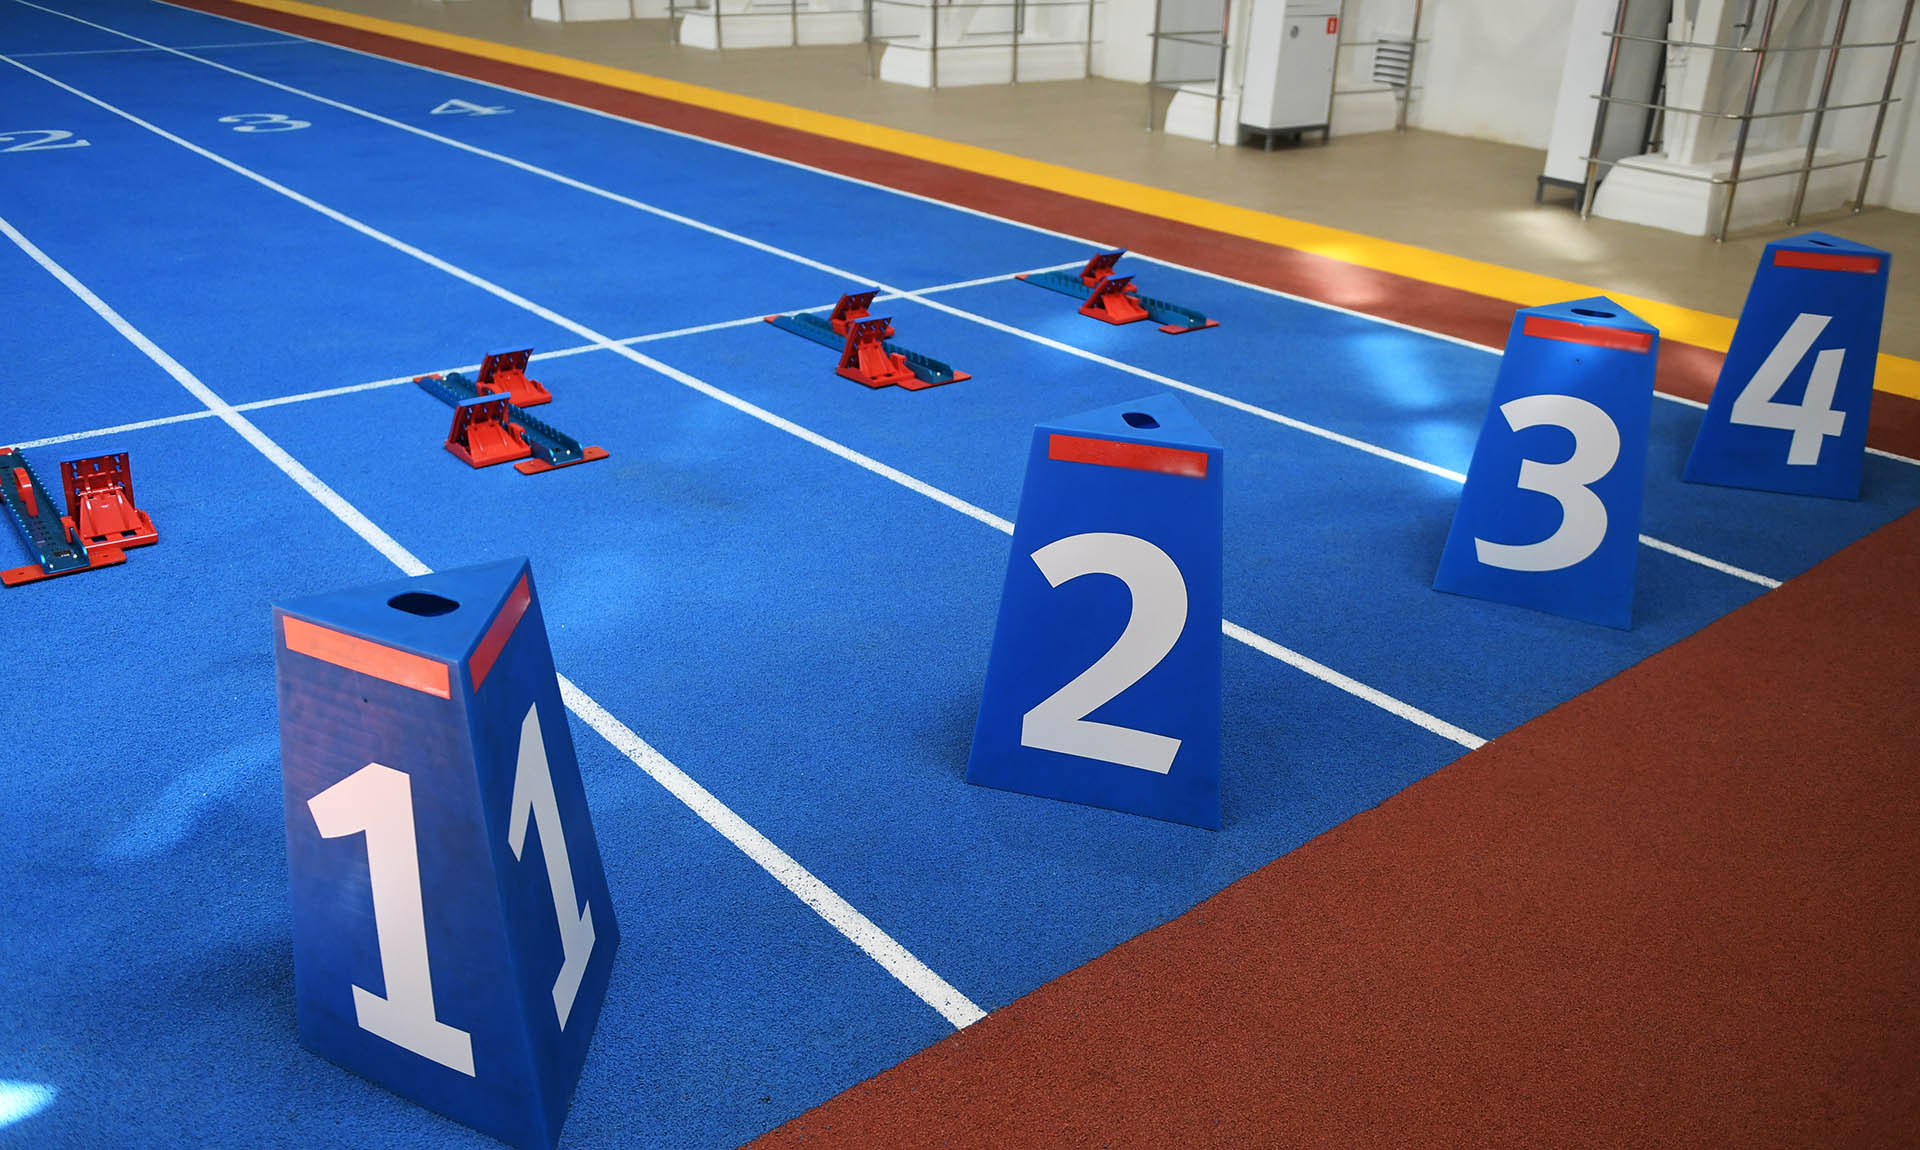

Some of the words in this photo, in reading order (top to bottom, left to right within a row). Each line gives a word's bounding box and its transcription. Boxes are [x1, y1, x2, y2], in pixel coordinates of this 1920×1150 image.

[0, 130, 91, 152] 2
[218, 113, 311, 132] 3
[430, 99, 515, 116] 4
[1730, 312, 1846, 466] 4
[1474, 394, 1621, 572] 3
[1020, 532, 1188, 775] 2
[306, 762, 476, 1078] 1
[508, 702, 596, 1032] 1
